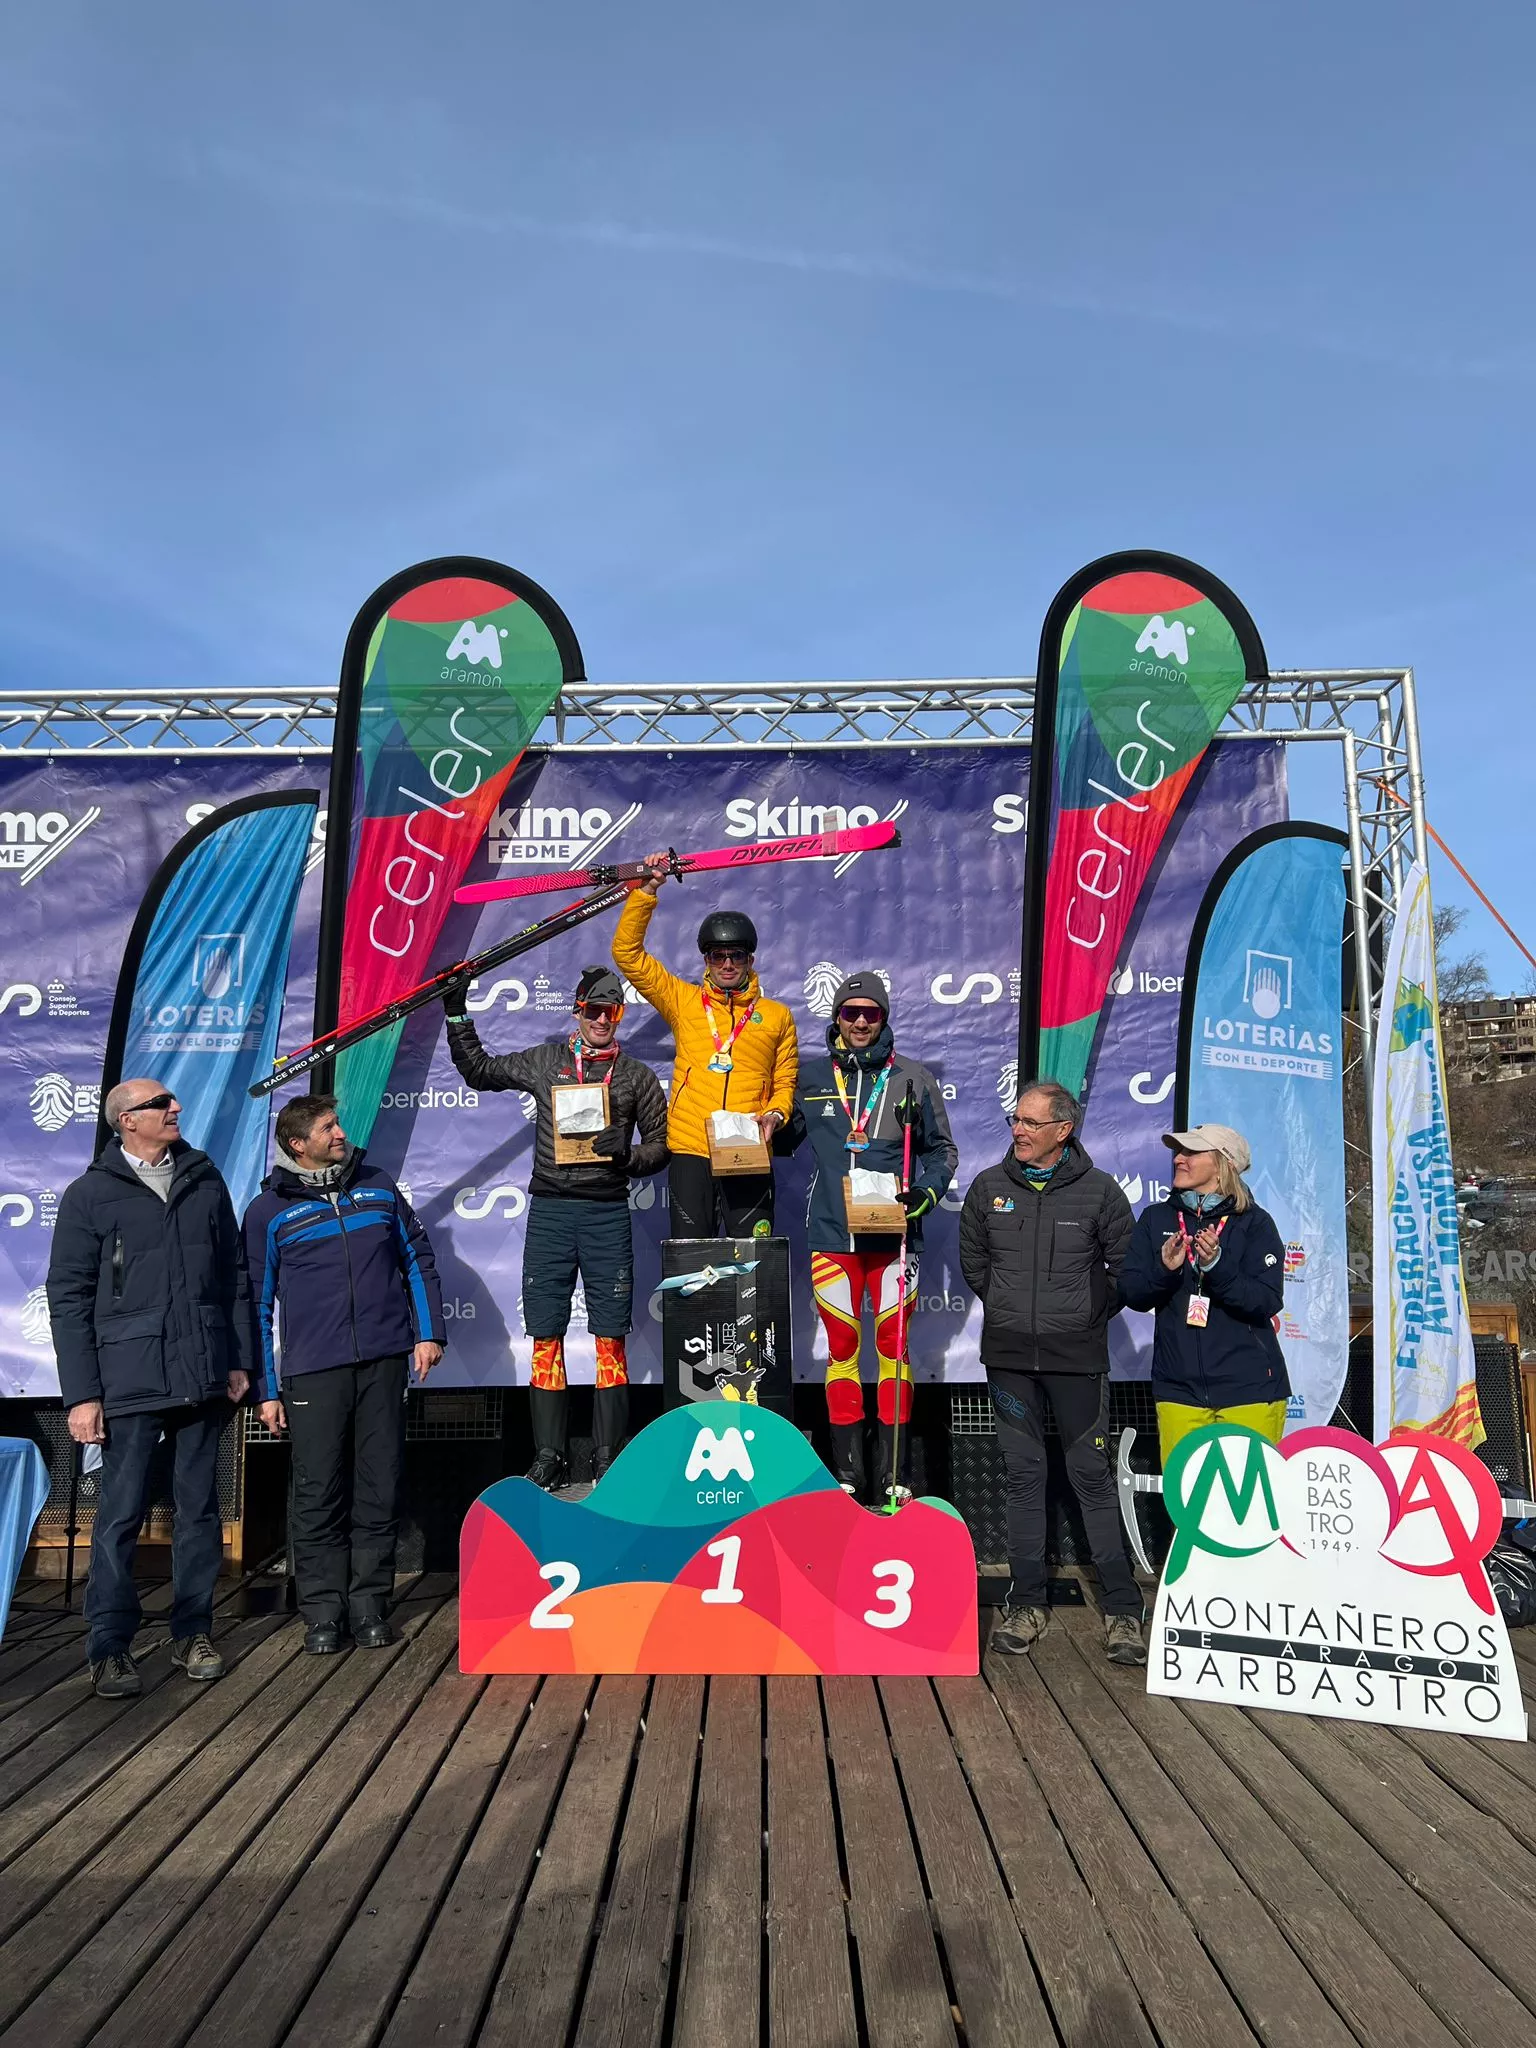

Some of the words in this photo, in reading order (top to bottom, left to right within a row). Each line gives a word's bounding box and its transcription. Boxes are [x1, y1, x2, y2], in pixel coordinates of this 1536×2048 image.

[440, 666, 502, 688] aramon
[1128, 658, 1188, 685] aramon
[0, 811, 70, 843] mo
[488, 798, 613, 838] kimo
[1066, 700, 1176, 949] cerler
[369, 707, 493, 957] cerler
[498, 845, 570, 859] FEDME
[729, 838, 824, 862] DYNAFI
[48, 995, 77, 1003] Consejo
[535, 991, 563, 999] Consejo
[535, 998, 564, 1006] Superior
[59, 1009, 90, 1017] Deportes
[545, 1004, 574, 1012] Deporte
[186, 1038, 201, 1047] EL
[1203, 1016, 1334, 1056] LOTERÍAS
[263, 1072, 289, 1088] RACE
[289, 1060, 308, 1074] PRO
[1215, 1052, 1241, 1064] CON
[1244, 1055, 1258, 1066] EL
[1261, 1058, 1318, 1074] DEPORTE
[286, 1204, 312, 1219] DESCENTE
[705, 1323, 713, 1367] SCOTT
[722, 1322, 734, 1367] WINTER
[1306, 1461, 1352, 1485] BAR
[696, 1488, 744, 1505] cerler
[1307, 1487, 1352, 1510] BAS
[1306, 1511, 1354, 1536] TRO
[701, 1535, 744, 1604] 1
[529, 1561, 581, 1629] 2
[863, 1559, 916, 1629] 3
[1164, 1592, 1498, 1660] MONTAÑEROS
[1165, 1627, 1213, 1650] DE
[1164, 1647, 1501, 1723] BARBASTRO
